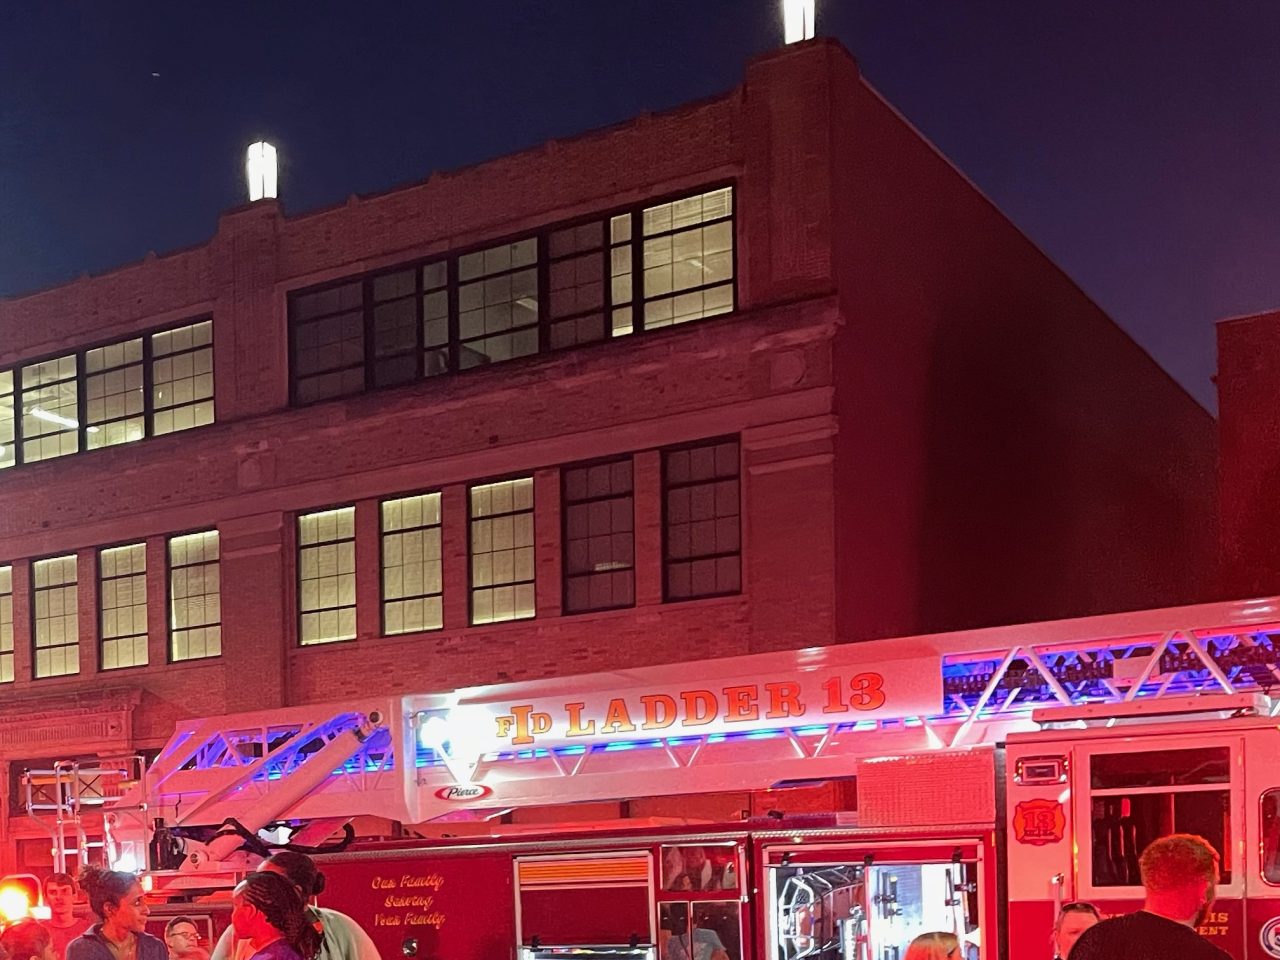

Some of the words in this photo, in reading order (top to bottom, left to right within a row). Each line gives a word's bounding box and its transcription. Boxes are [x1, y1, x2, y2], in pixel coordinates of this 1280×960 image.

[564, 680, 806, 738] LADDER
[822, 672, 886, 714] 13
[447, 786, 480, 799] Pierce
[1023, 811, 1056, 831] 13
[371, 876, 397, 890] Our
[400, 873, 445, 892] Family
[384, 895, 434, 912] Serving
[374, 913, 401, 926] Your
[404, 912, 446, 930] Family
